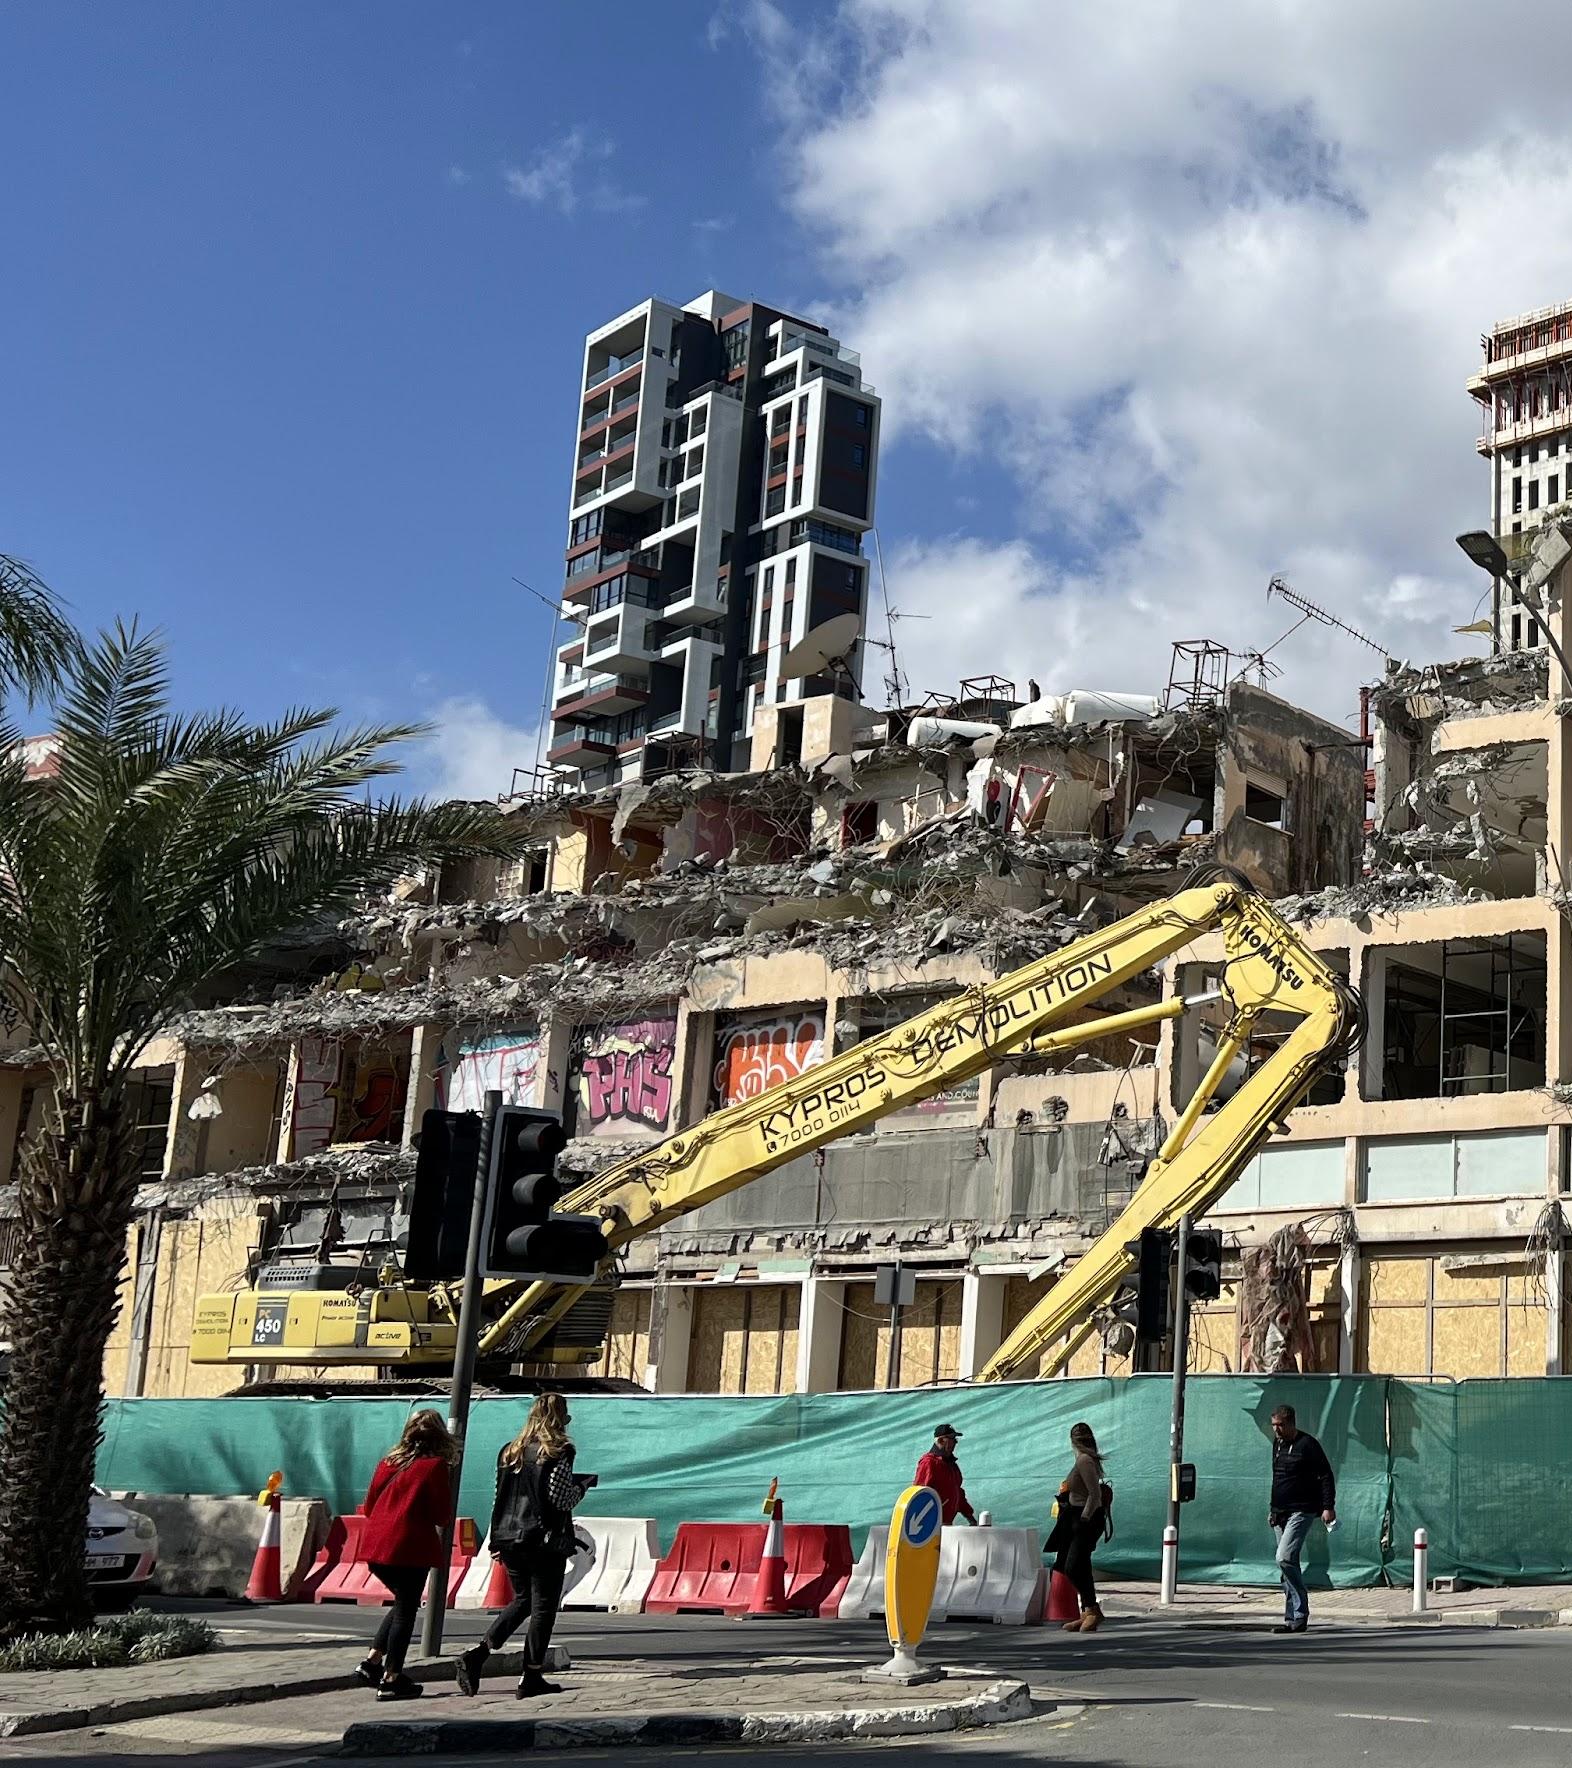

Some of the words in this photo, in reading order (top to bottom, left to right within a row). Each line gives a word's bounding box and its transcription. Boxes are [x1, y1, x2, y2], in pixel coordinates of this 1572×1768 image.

[1240, 924, 1304, 990] KOMATSU
[759, 1066, 887, 1140] KYPROS
[910, 953, 1113, 1065] DEMOLITION
[778, 1119, 824, 1147] 7000
[829, 1099, 862, 1124] 0114
[322, 1298, 357, 1307] KOMATSU
[258, 1309, 271, 1318] PC
[255, 1318, 281, 1334] 450
[254, 1334, 266, 1343] LC
